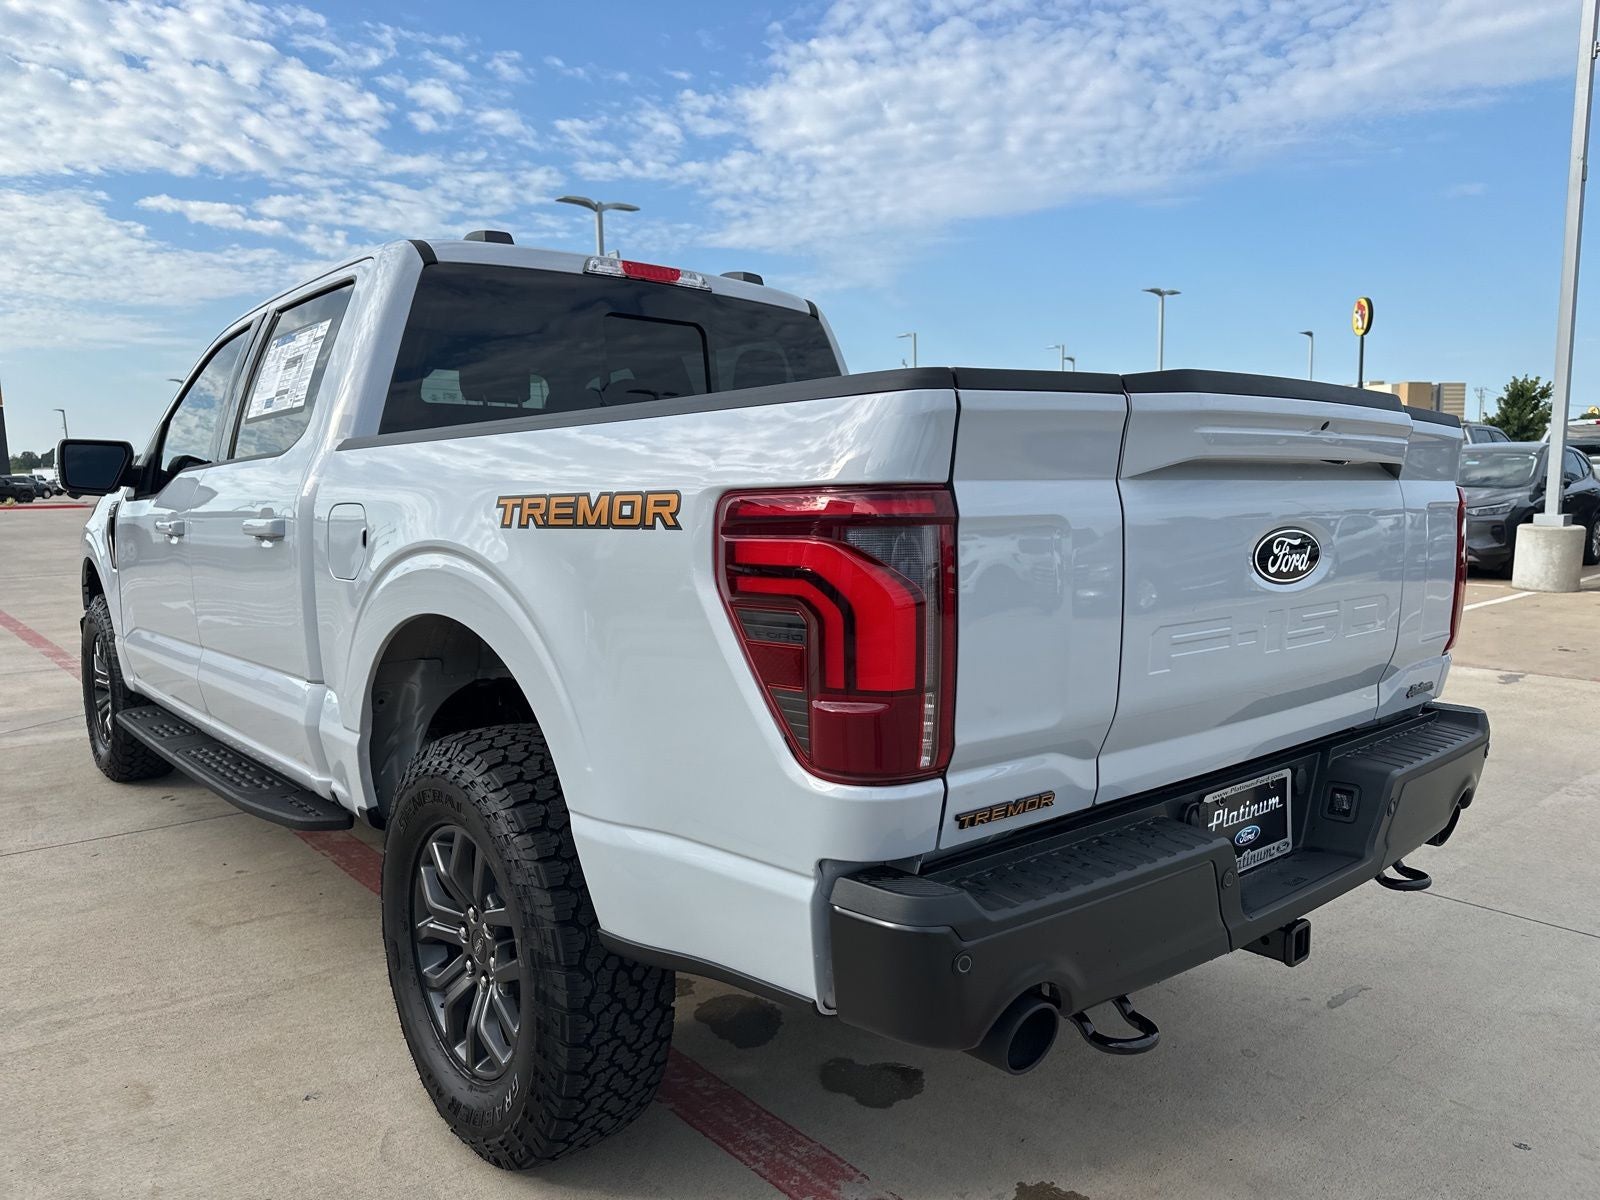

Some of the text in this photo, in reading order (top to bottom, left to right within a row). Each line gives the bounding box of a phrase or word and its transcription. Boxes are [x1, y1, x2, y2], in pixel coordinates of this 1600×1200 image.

[497, 490, 682, 530] TREMOR
[1267, 536, 1312, 574] Ford
[1148, 594, 1390, 676] F-150
[1211, 772, 1284, 800] www.PlatinumFord.com
[955, 790, 1056, 829] TREMOR
[1207, 795, 1284, 832] Platinum
[1239, 828, 1256, 844] Ford
[1236, 847, 1274, 869] atinum
